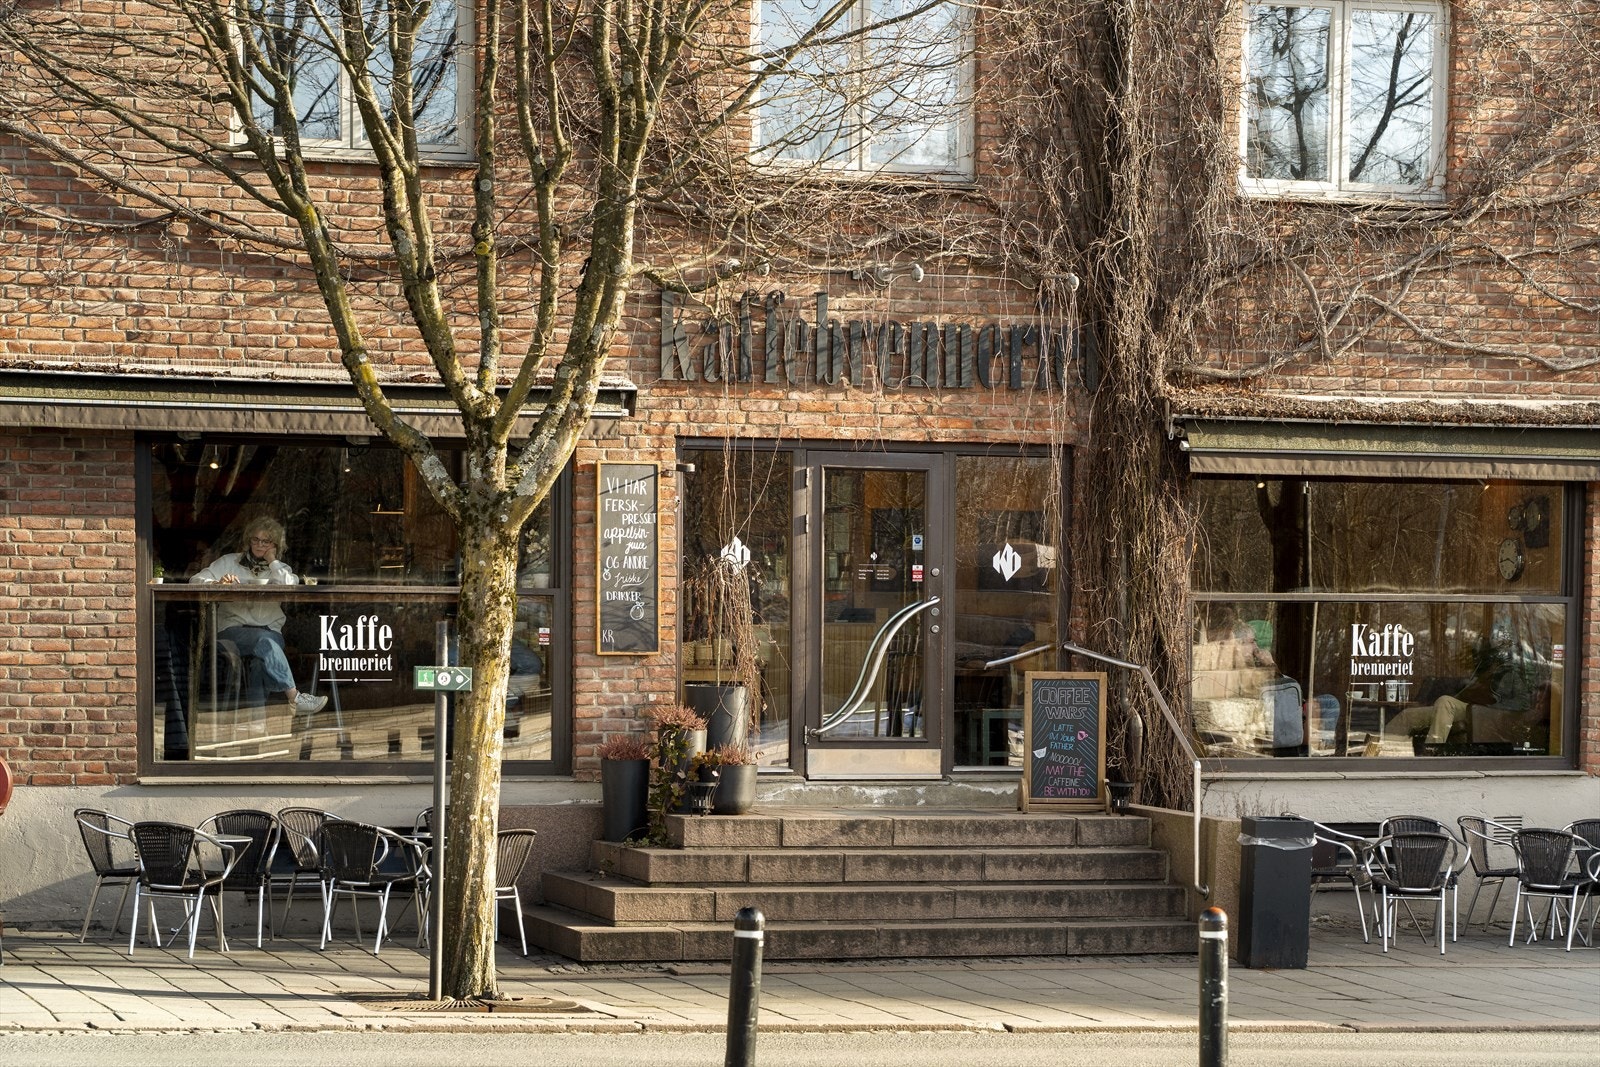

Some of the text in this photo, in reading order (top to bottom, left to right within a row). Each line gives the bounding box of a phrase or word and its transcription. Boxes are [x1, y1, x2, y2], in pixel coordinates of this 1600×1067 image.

[606, 477, 647, 496] VI HAR
[605, 498, 645, 512] FERSK-
[622, 512, 657, 525] PRESSET
[606, 555, 650, 570] OG ANDRE
[613, 572, 643, 588] friske
[605, 591, 641, 602] DRIKKER
[319, 614, 393, 651] Kaffe
[602, 629, 615, 644] KR
[1351, 624, 1414, 656] Kaffe
[319, 652, 393, 672] brenneriet
[1351, 659, 1413, 675] brenneriet
[1038, 686, 1091, 705] COFFEE
[1044, 706, 1088, 720] WARS
[1053, 723, 1074, 732] LATTE
[1050, 741, 1074, 751] FATHER
[1045, 765, 1086, 777] MAY THE
[1048, 776, 1081, 787] CAFFEINE
[1043, 785, 1055, 797] BE
[1056, 787, 1077, 796] WITH
